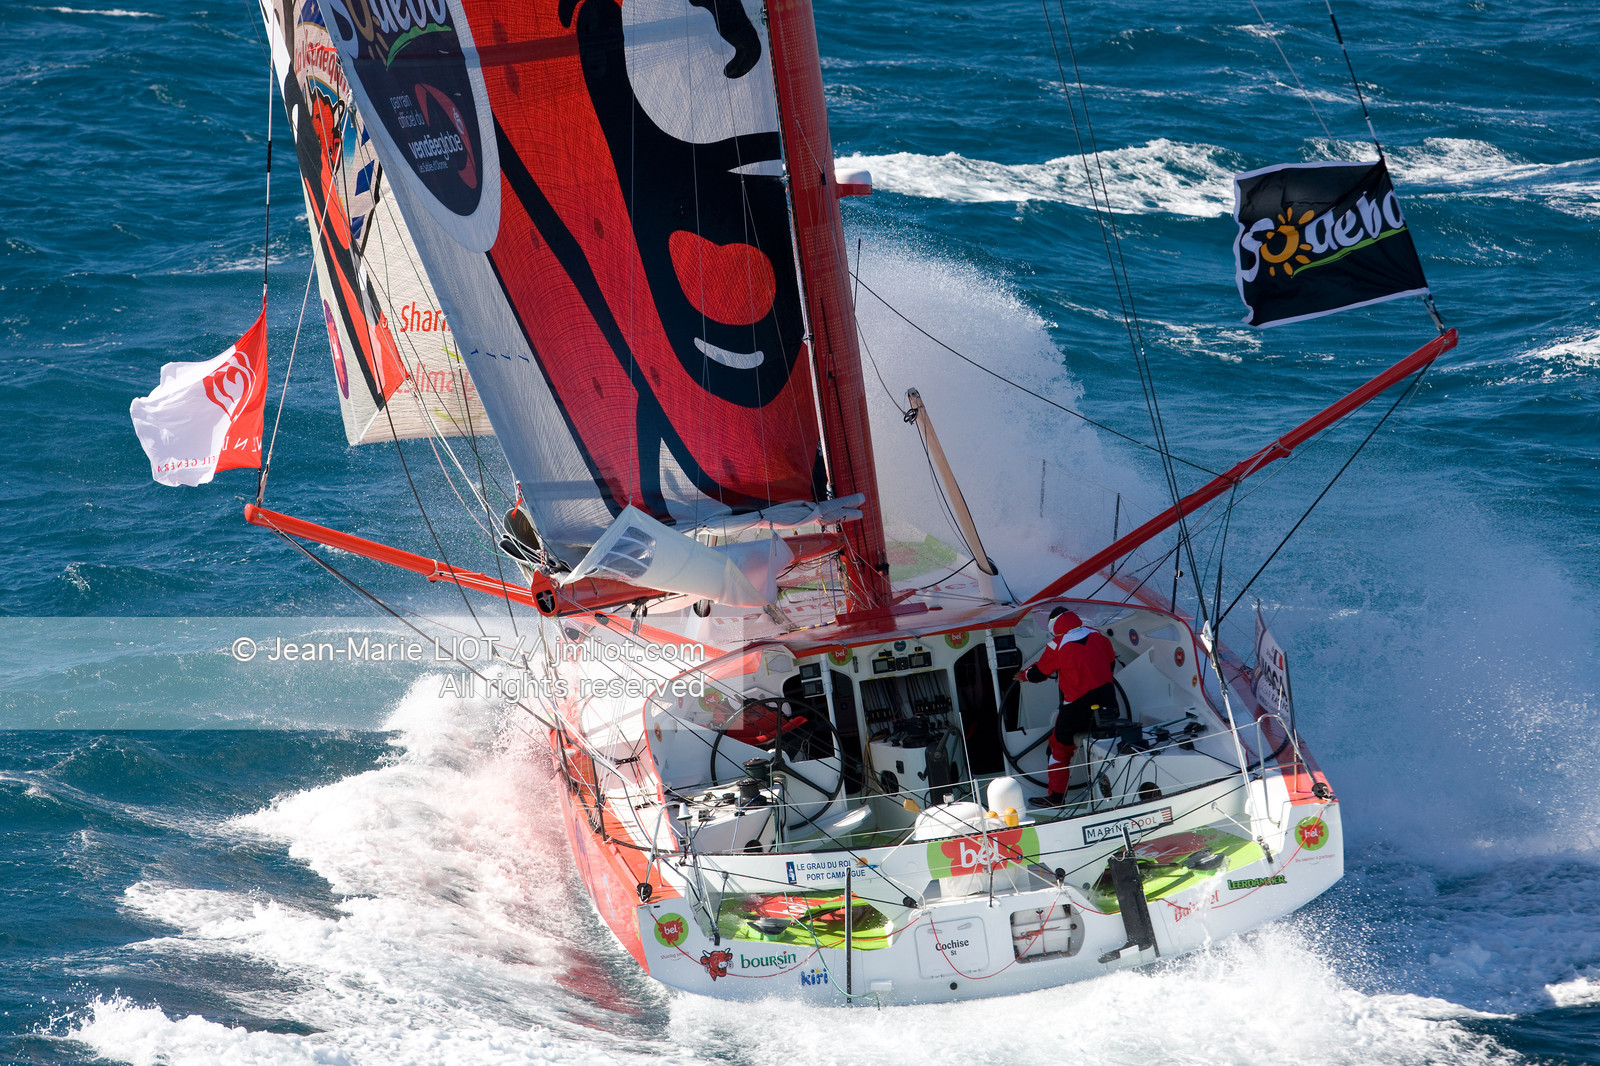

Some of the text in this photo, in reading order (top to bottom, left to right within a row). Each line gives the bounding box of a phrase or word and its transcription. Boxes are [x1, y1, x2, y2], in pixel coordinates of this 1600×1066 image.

[951, 633, 962, 641] bel
[834, 649, 845, 658] bel
[960, 837, 1002, 868] bel
[796, 860, 851, 871] LE GRAU DU ROI
[806, 870, 866, 881] PORT CAMAGUE
[663, 924, 679, 935] bel
[935, 939, 970, 952] Cochise
[800, 967, 829, 987] kiri
